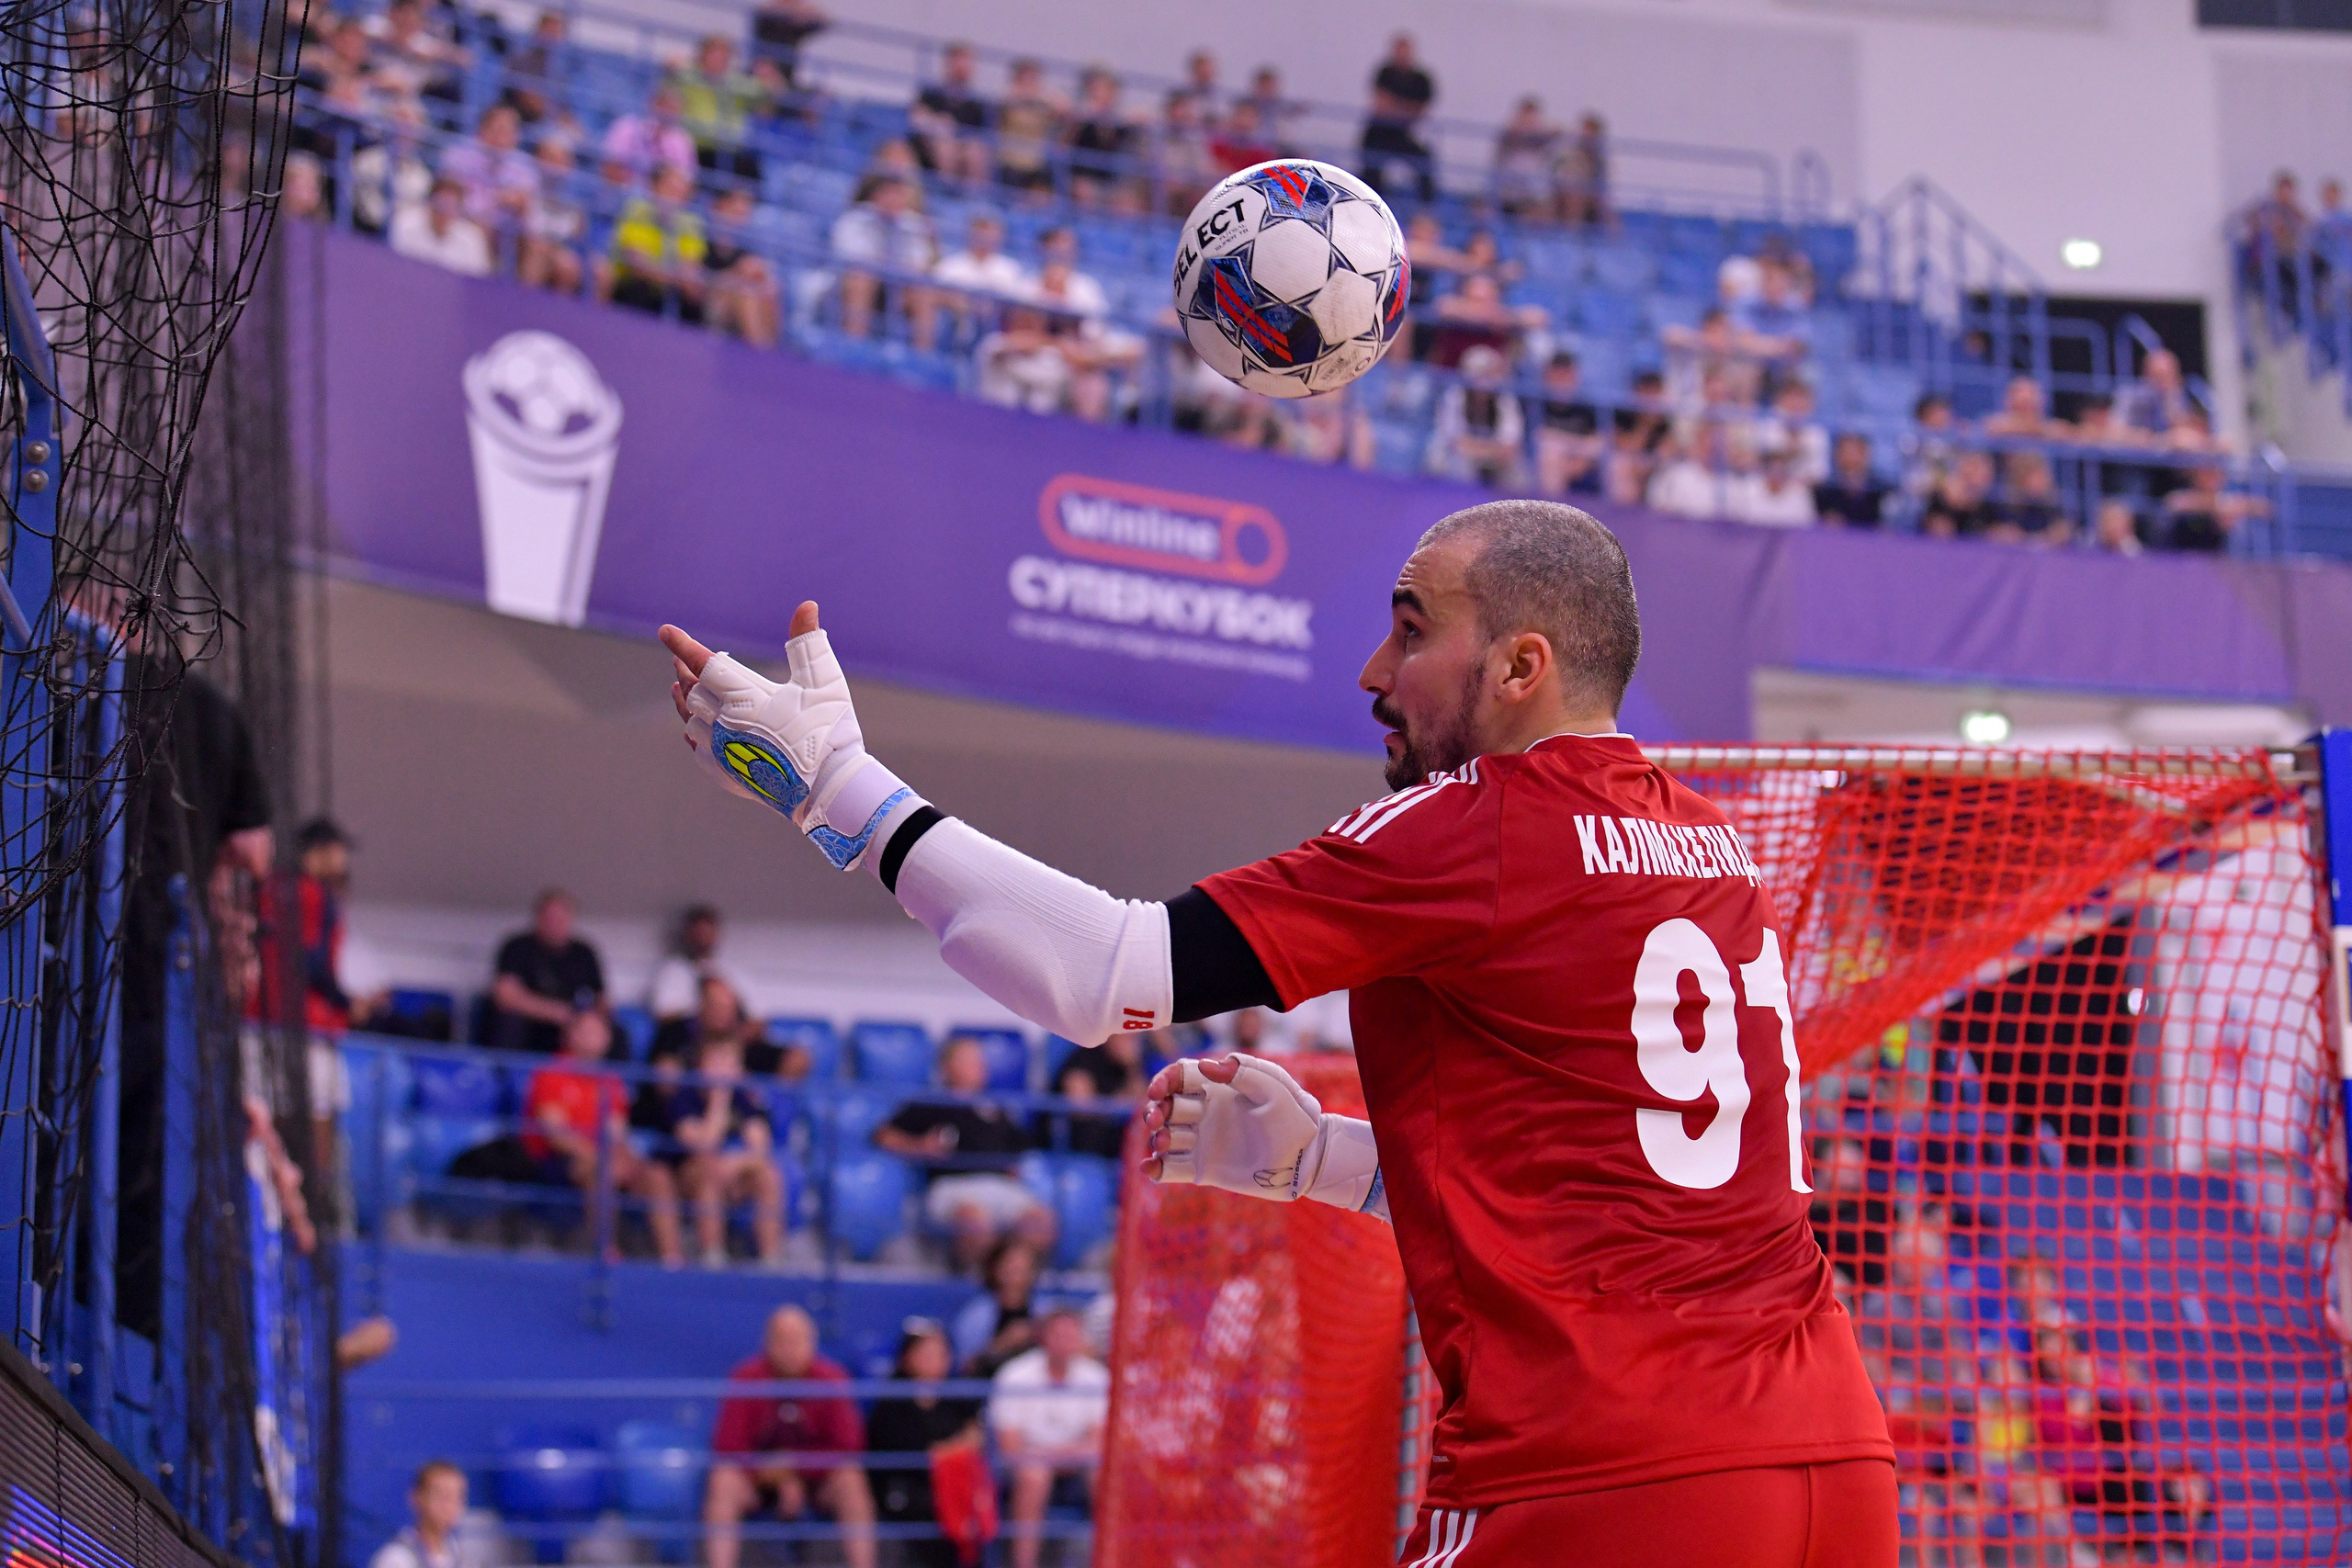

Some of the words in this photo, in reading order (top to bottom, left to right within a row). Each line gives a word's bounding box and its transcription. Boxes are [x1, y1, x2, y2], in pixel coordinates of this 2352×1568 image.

[1174, 198, 1245, 298] SELECT
[1574, 815, 1765, 889] КАЛМАХЕЛИД
[1631, 918, 1815, 1193] 91
